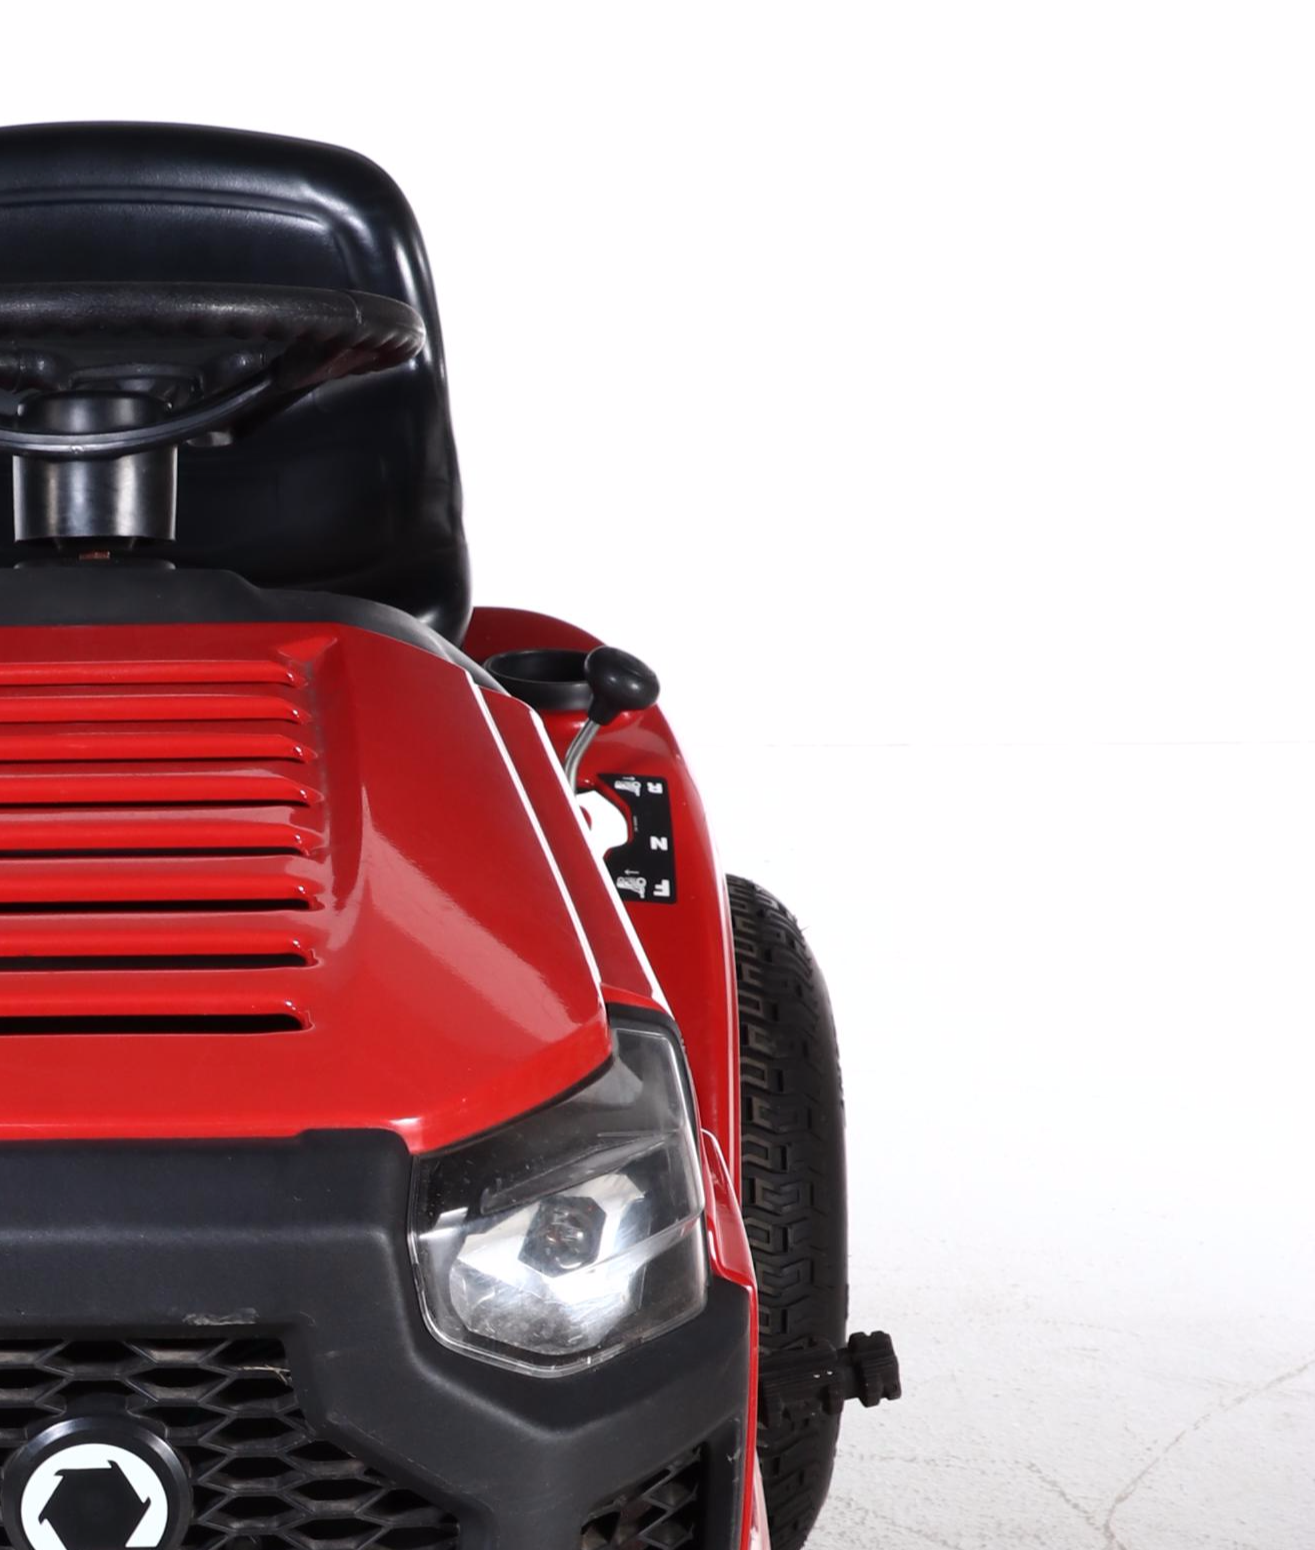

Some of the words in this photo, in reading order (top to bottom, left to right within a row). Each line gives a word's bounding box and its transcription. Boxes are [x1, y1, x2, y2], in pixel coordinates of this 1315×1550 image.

[647, 782, 663, 794] R
[650, 836, 668, 851] N
[653, 879, 670, 897] F
